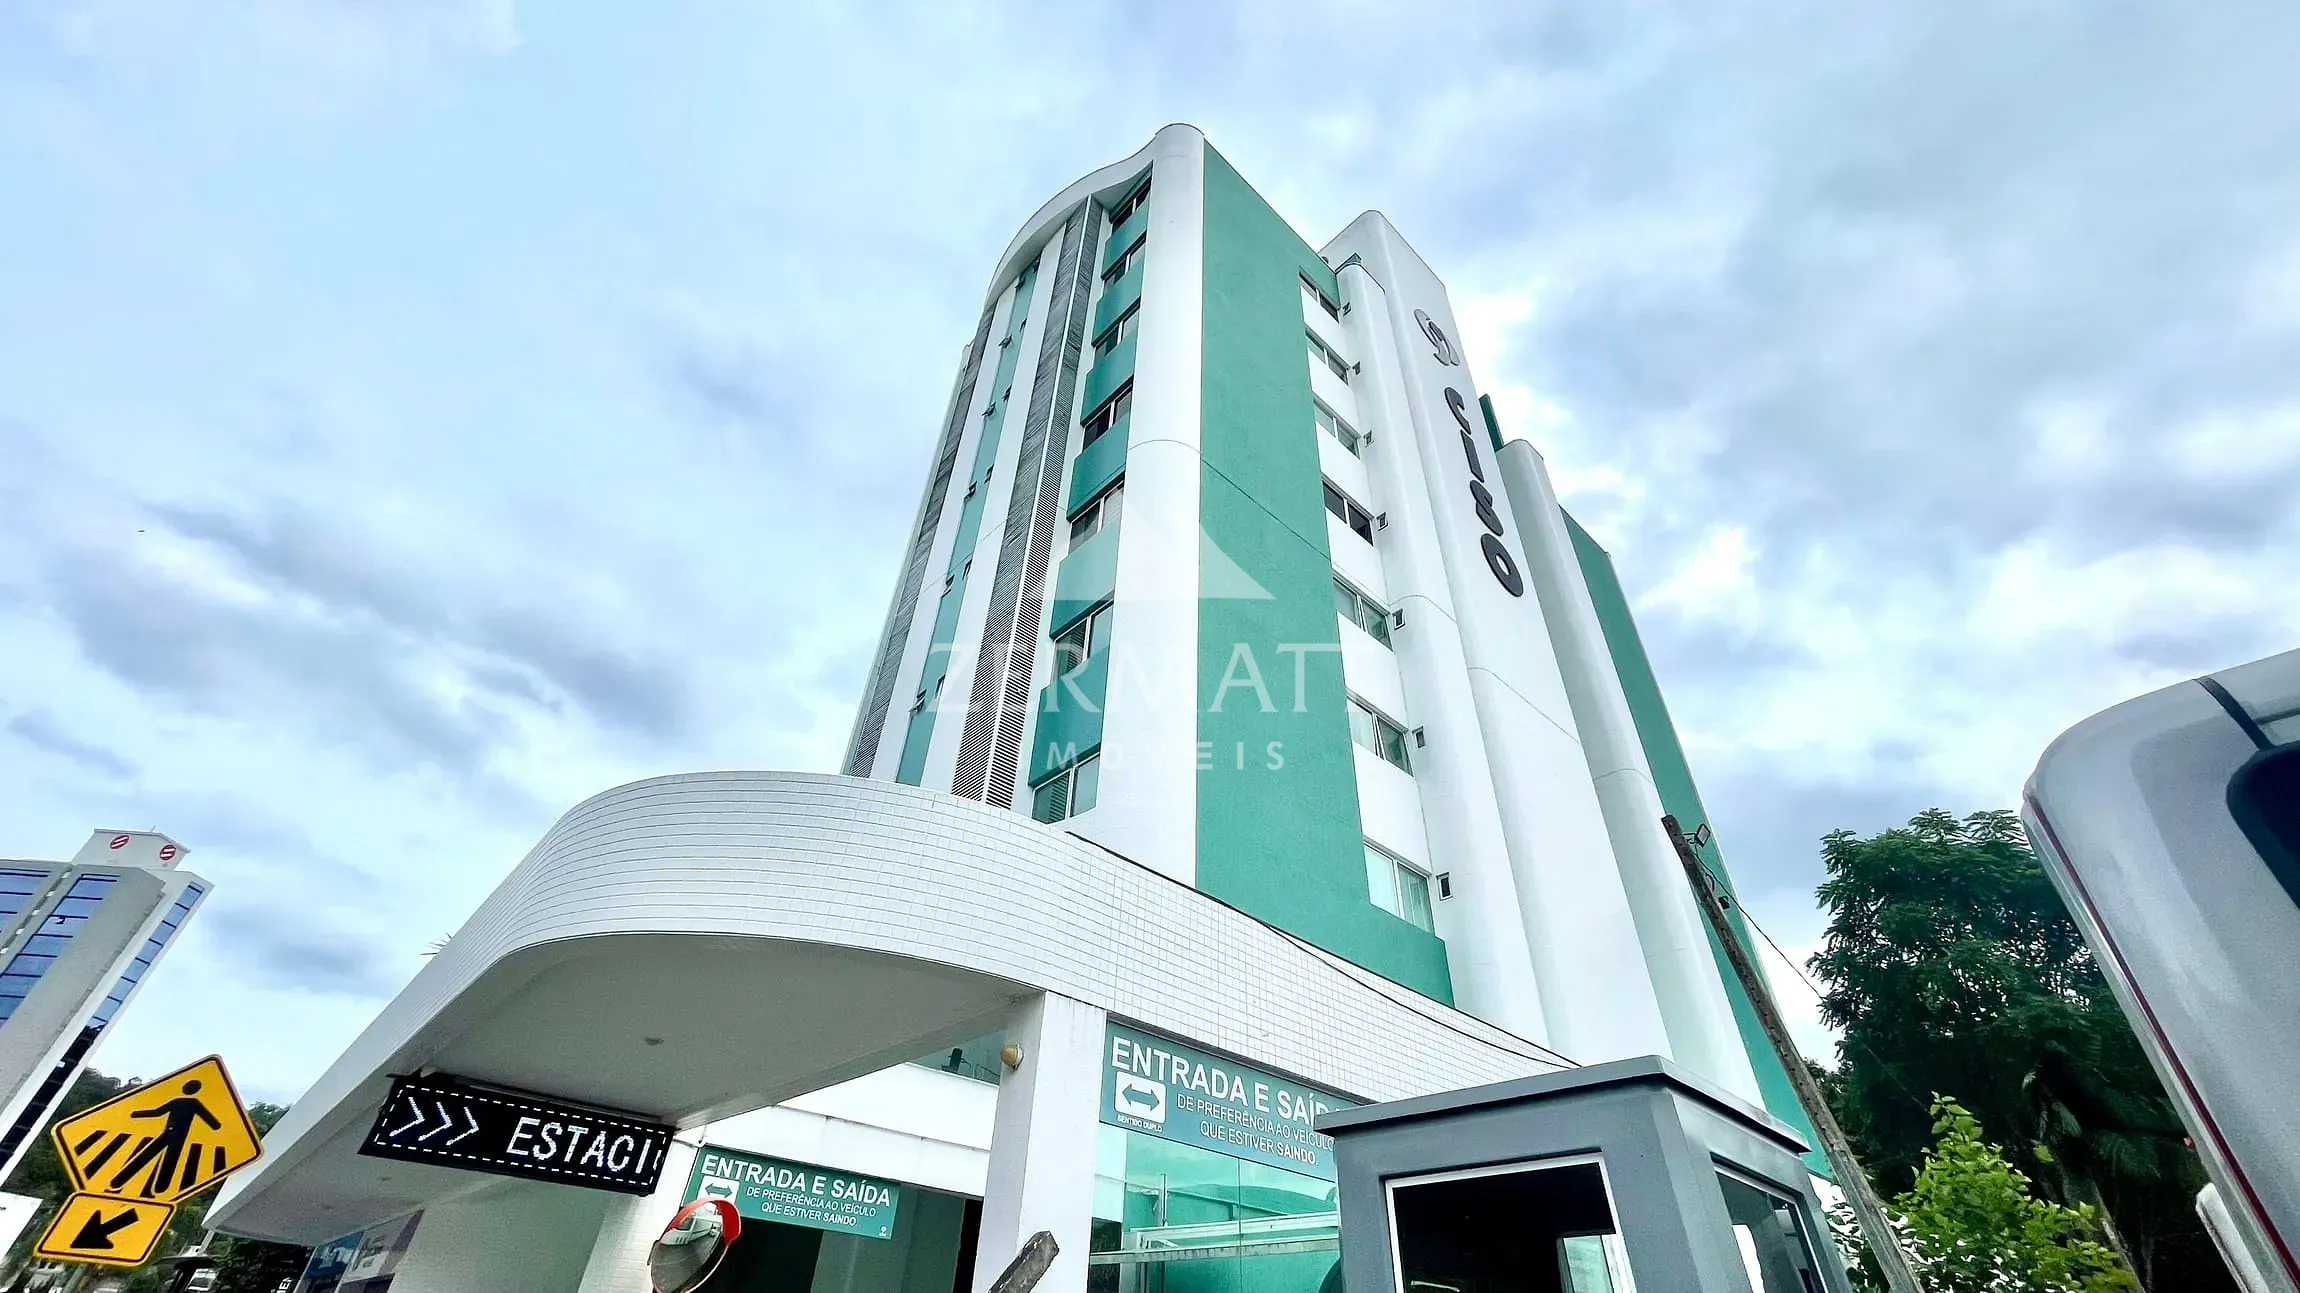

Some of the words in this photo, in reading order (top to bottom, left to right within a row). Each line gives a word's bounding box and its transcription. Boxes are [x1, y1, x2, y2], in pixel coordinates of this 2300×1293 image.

[1111, 1035, 1249, 1106] ENTRADA
[1255, 1080, 1270, 1113] E
[1117, 1114, 1143, 1127] SENTIDO
[1177, 1093, 1194, 1112] DE
[1197, 1099, 1275, 1135] PREFERÊNCIA
[1275, 1122, 1290, 1139] AO
[1292, 1127, 1334, 1151] VEÍCULO
[1200, 1120, 1226, 1141] QUE
[1229, 1128, 1274, 1152] ESTIVER
[701, 1153, 806, 1193] ENTRADA
[812, 1175, 827, 1195] E
[831, 1179, 891, 1207] SAÍDA
[746, 1186, 760, 1198] DE
[762, 1187, 826, 1209] PREFERÊNCIA
[826, 1200, 839, 1211] AO
[840, 1201, 876, 1217] VEÍCULO
[761, 1201, 782, 1215] QUE
[783, 1205, 822, 1220] ESTIVER
[822, 1212, 857, 1227] SAINDO
